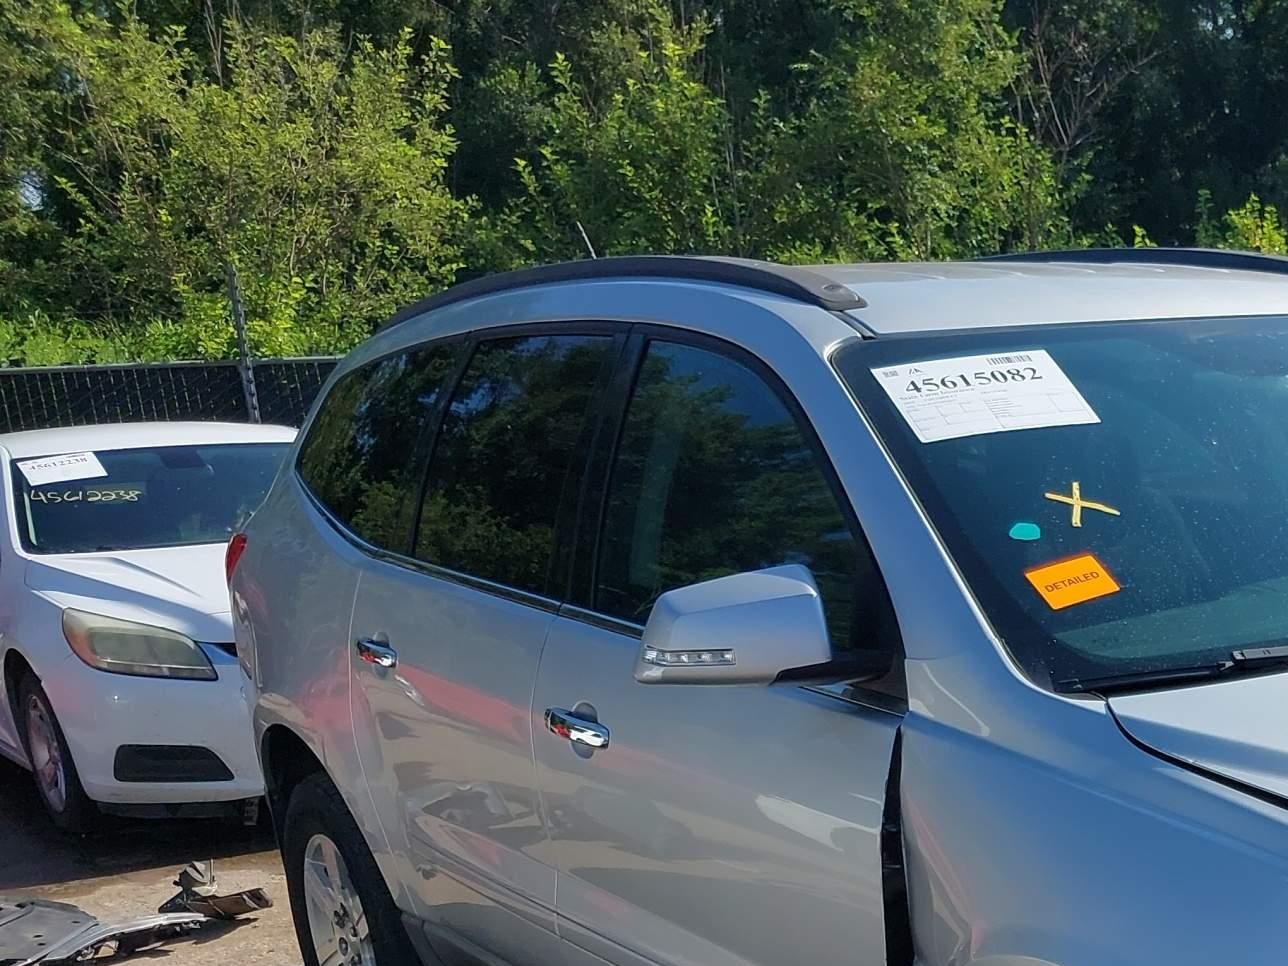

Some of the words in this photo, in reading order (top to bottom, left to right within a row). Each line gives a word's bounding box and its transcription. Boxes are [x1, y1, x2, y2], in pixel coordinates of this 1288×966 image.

[905, 367, 1043, 393] 45615082
[30, 489, 142, 504] 45612238
[1044, 571, 1100, 593] DETAILED
